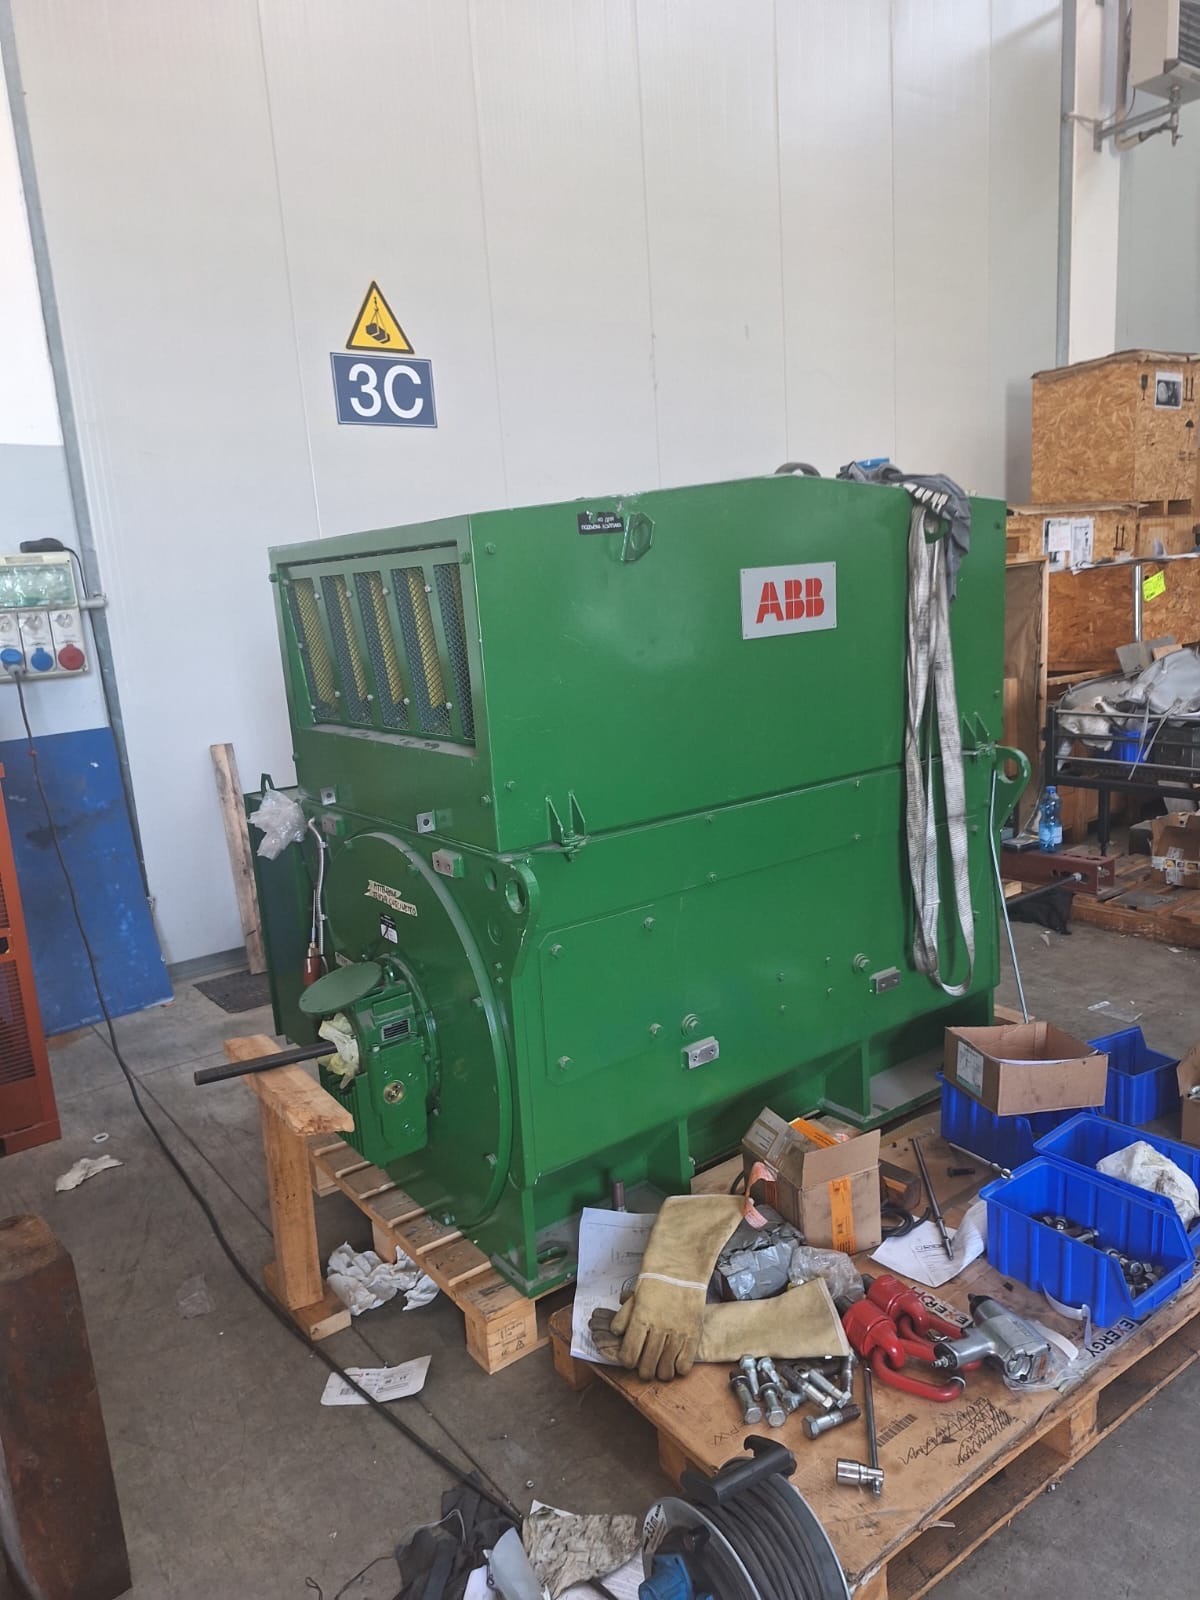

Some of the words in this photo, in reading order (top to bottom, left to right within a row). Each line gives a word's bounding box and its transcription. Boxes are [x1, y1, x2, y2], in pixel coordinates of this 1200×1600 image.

[349, 363, 424, 419] 3C
[756, 578, 825, 624] ABB
[1085, 1319, 1135, 1358] EXERGY
